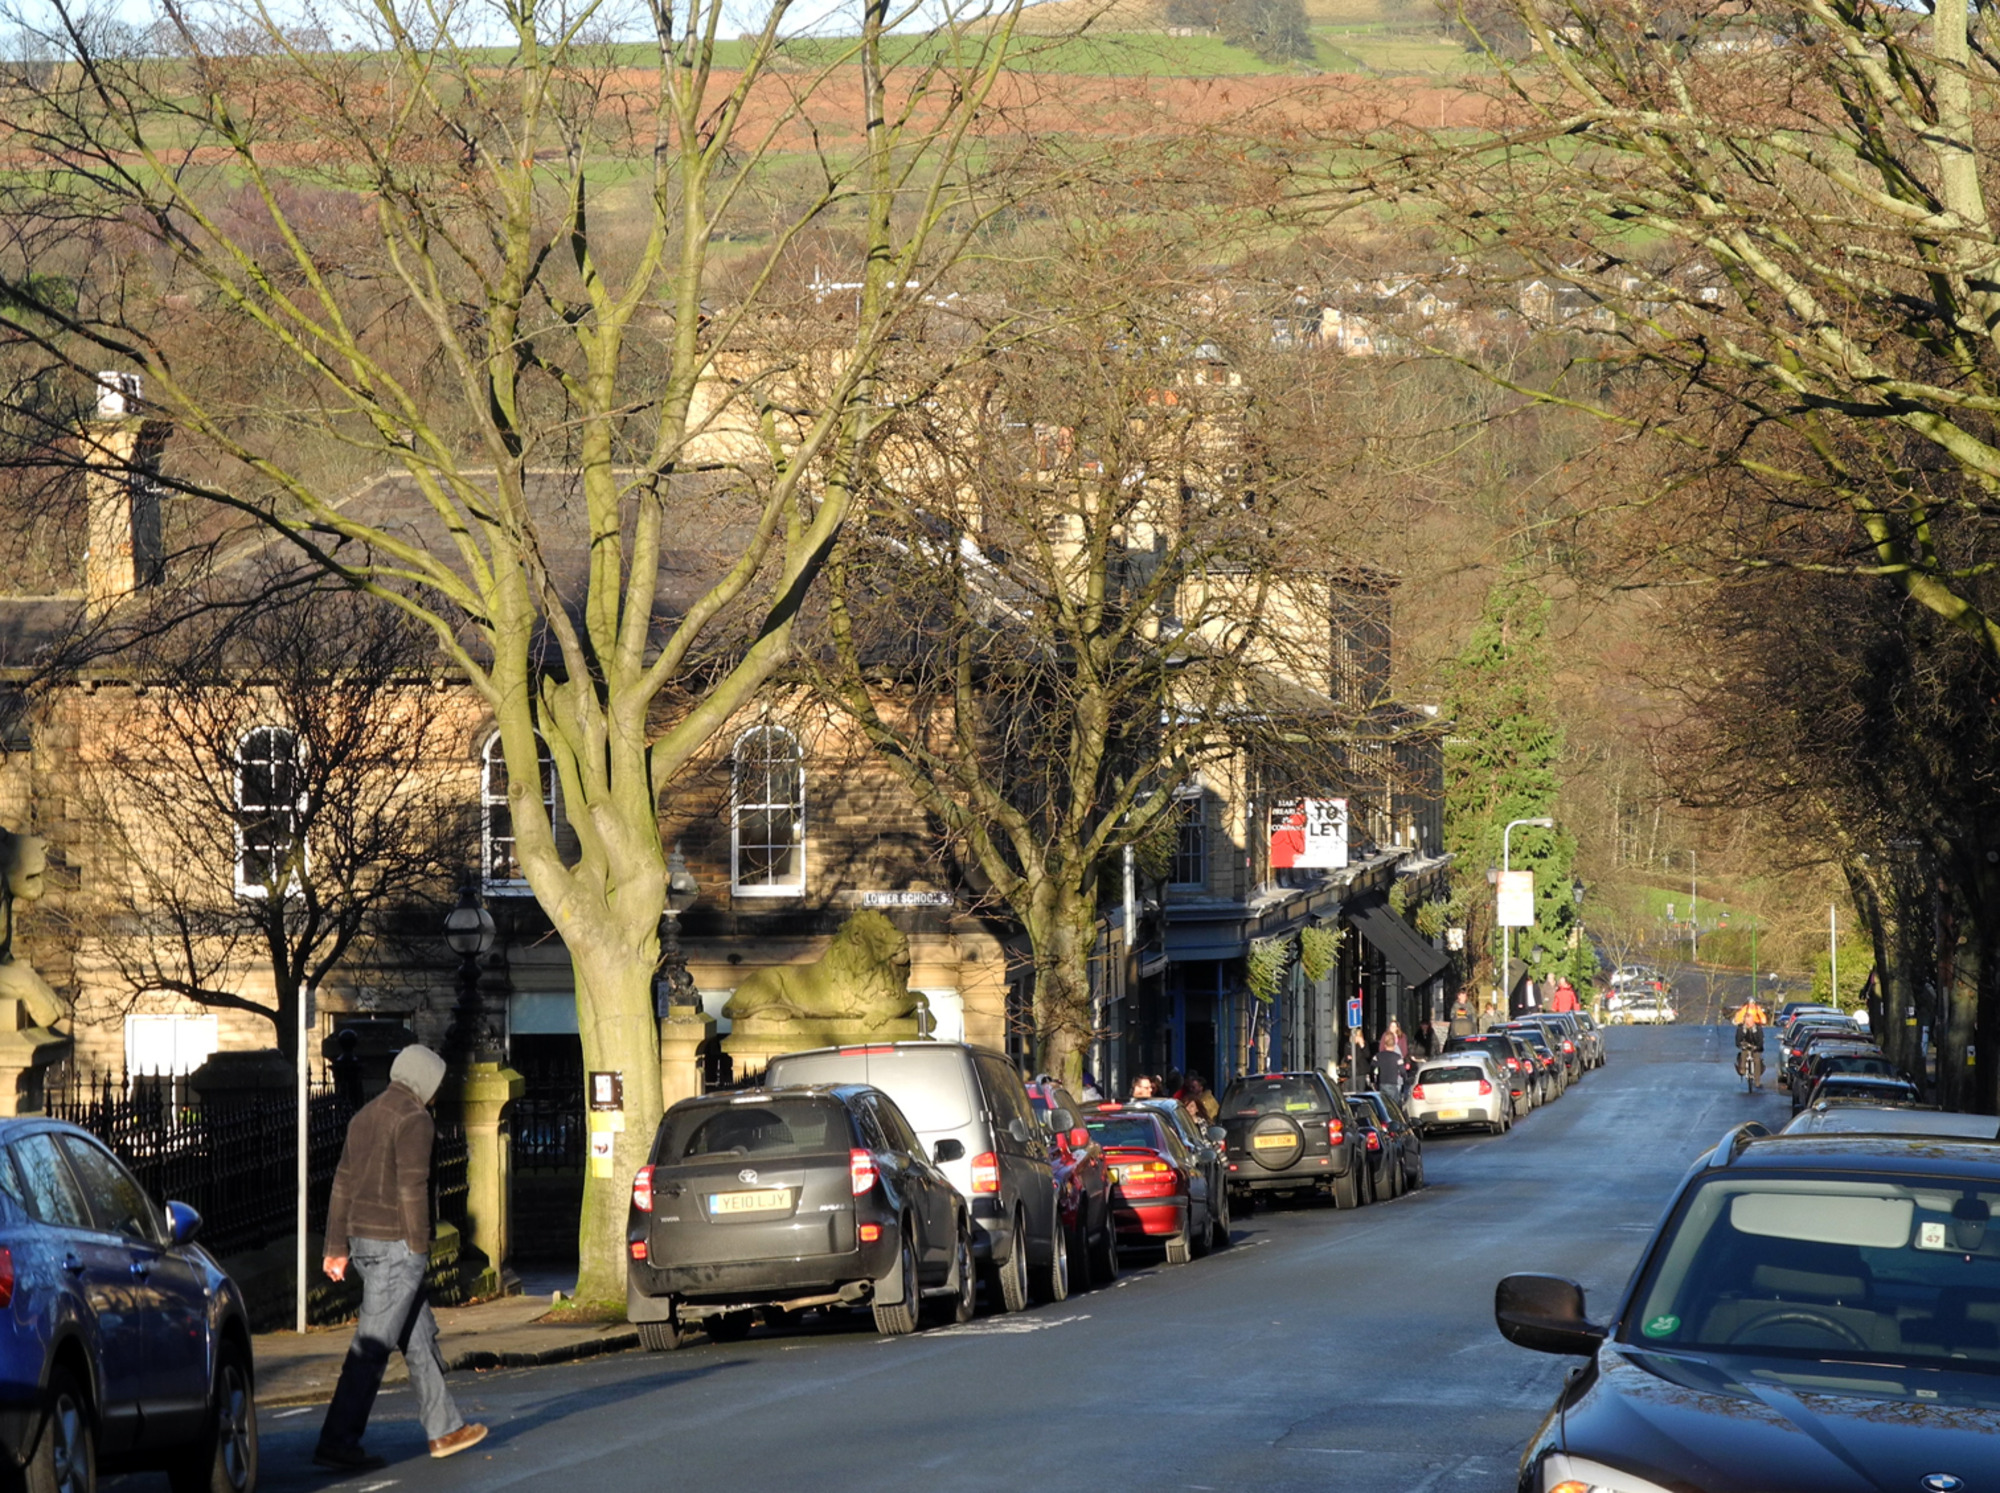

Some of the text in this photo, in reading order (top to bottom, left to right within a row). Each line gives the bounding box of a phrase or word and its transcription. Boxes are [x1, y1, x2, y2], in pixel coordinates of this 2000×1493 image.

[1315, 806, 1338, 820] TO
[1310, 823, 1342, 836] LET
[866, 893, 899, 904] LOWER
[901, 893, 939, 904] SCHOOL
[757, 1193, 785, 1208] LJY
[1925, 1234, 1941, 1243] 47
